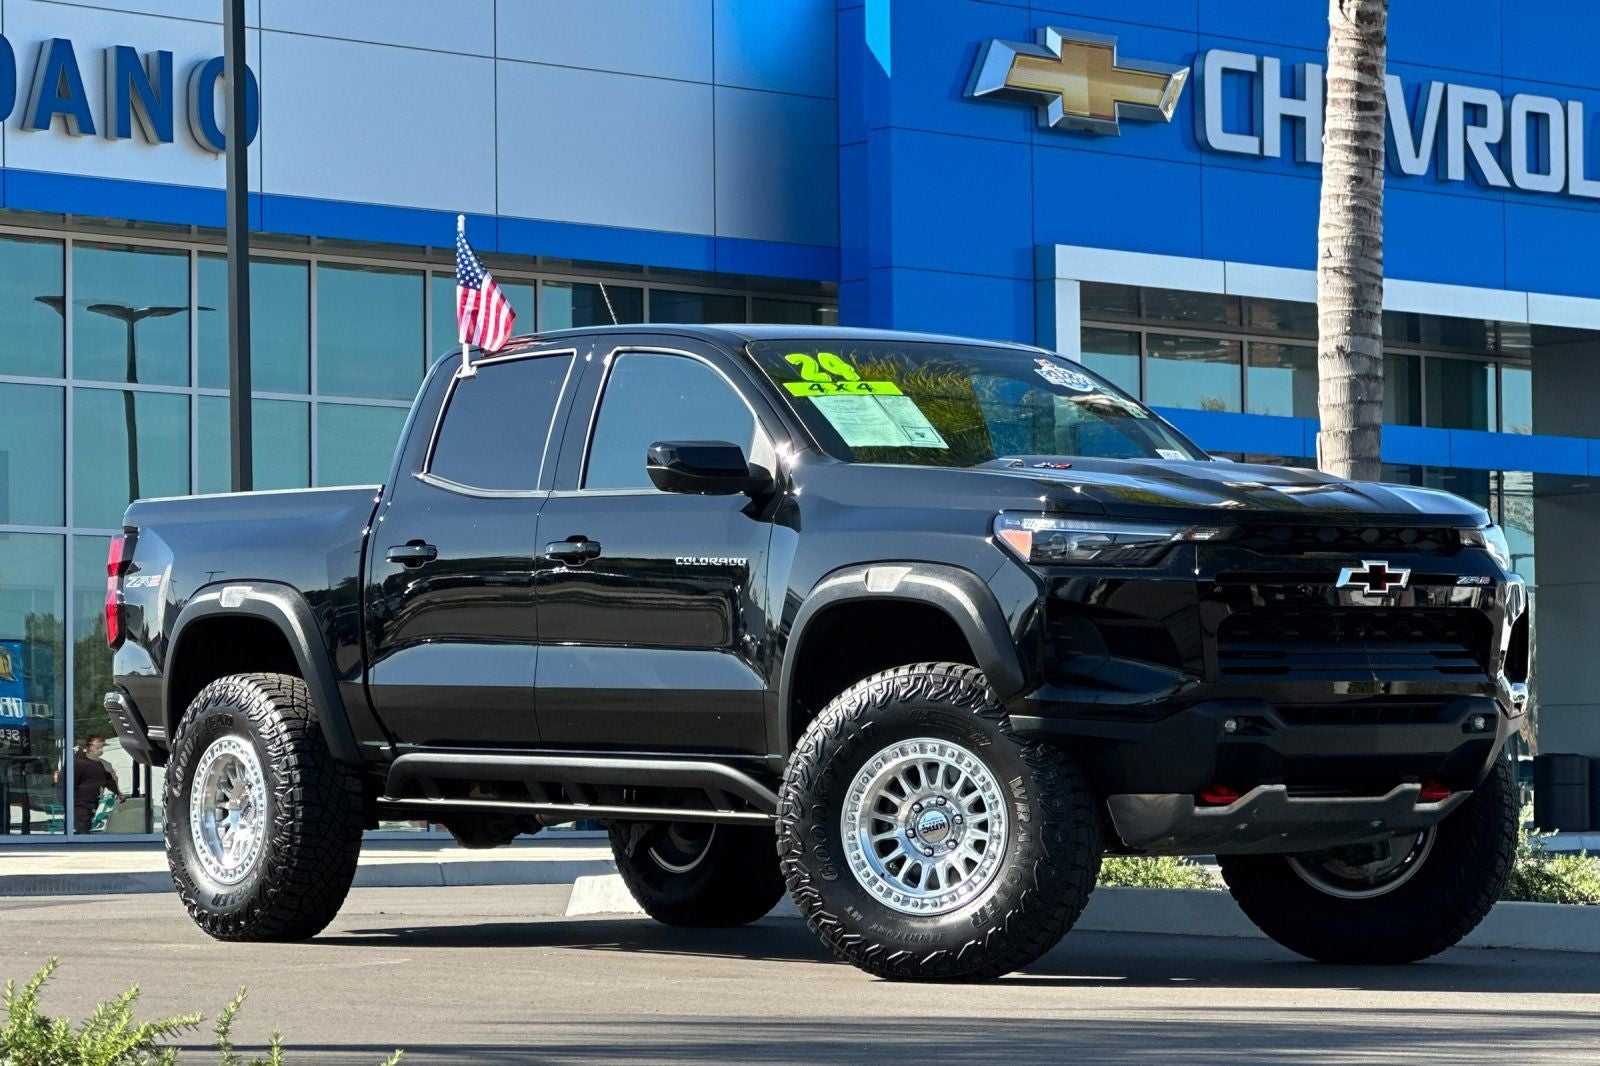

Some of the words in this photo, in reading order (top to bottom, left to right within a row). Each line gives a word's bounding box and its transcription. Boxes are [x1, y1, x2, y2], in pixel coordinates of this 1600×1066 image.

[0, 34, 260, 153] ANO
[1197, 49, 1600, 198] CHVROL
[785, 352, 860, 382] 24
[674, 556, 748, 566] COLORADO
[125, 574, 162, 588] ZR2
[1456, 576, 1491, 585] ZR2
